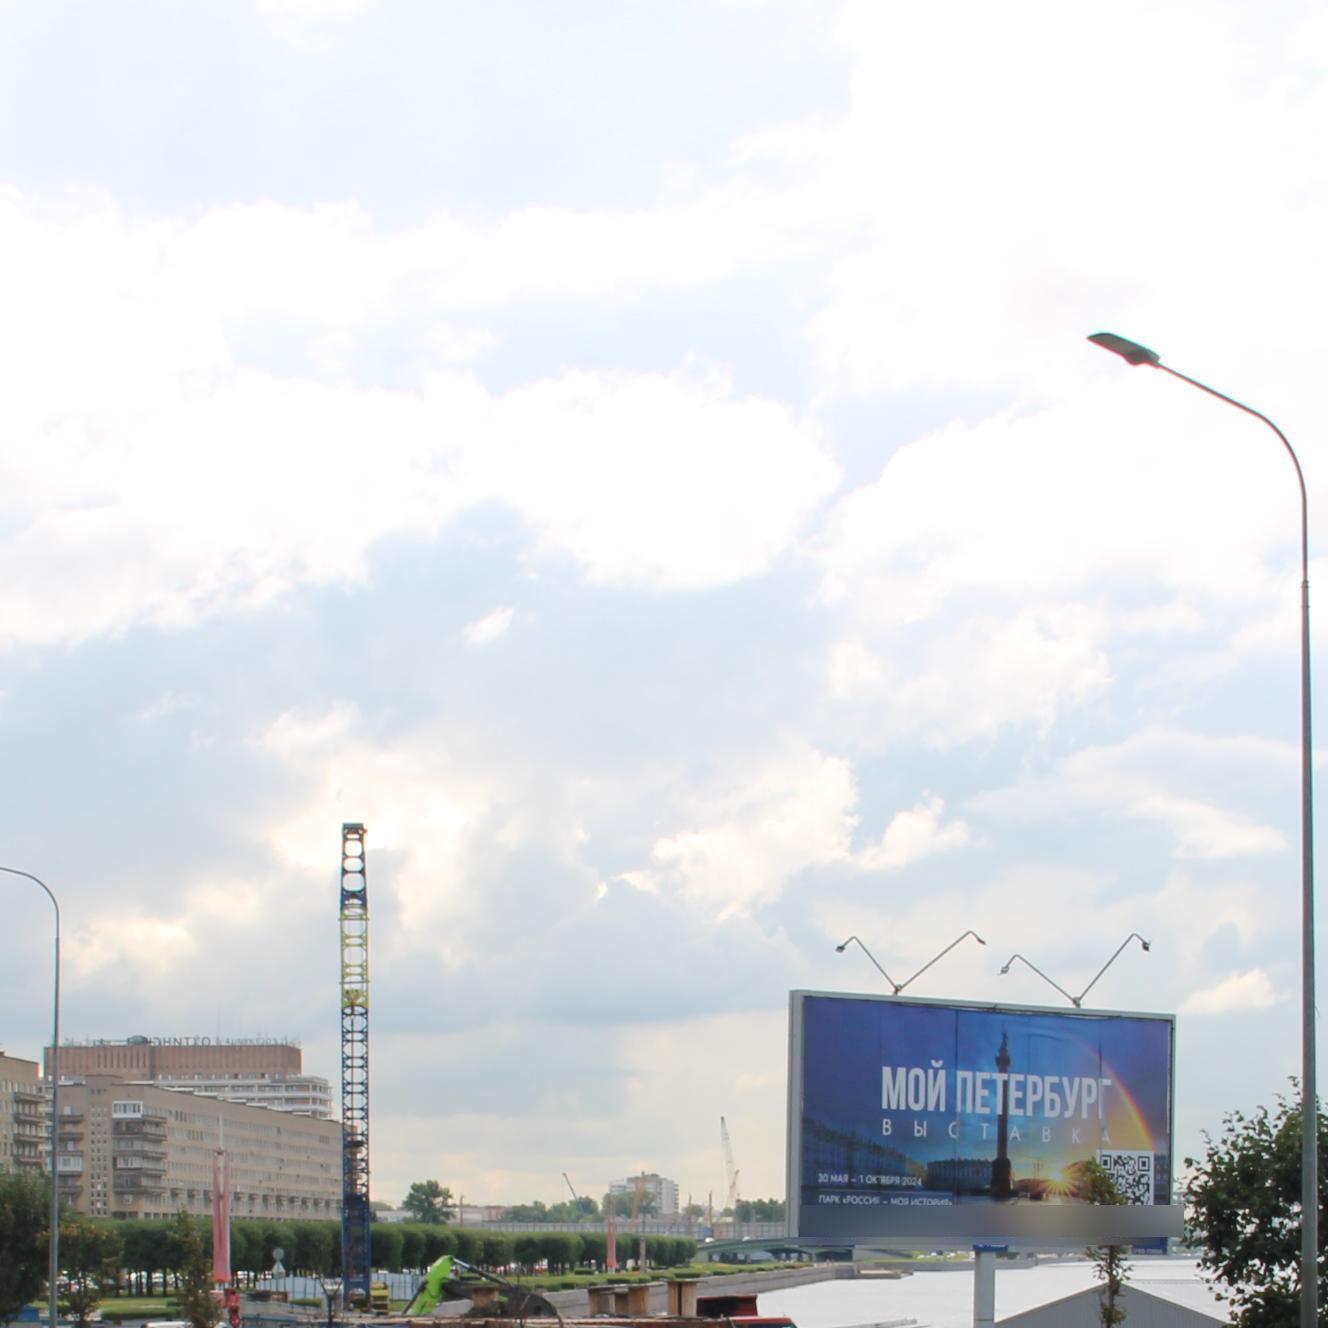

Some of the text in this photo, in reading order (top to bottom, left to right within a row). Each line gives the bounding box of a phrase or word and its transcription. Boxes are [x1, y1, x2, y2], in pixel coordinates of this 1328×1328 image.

[881, 1059, 1112, 1121] МОЙ ПЕТЕРБУРГ
[881, 1117, 1112, 1146] ВЫСТАВКА
[830, 1173, 849, 1184] МАЯ
